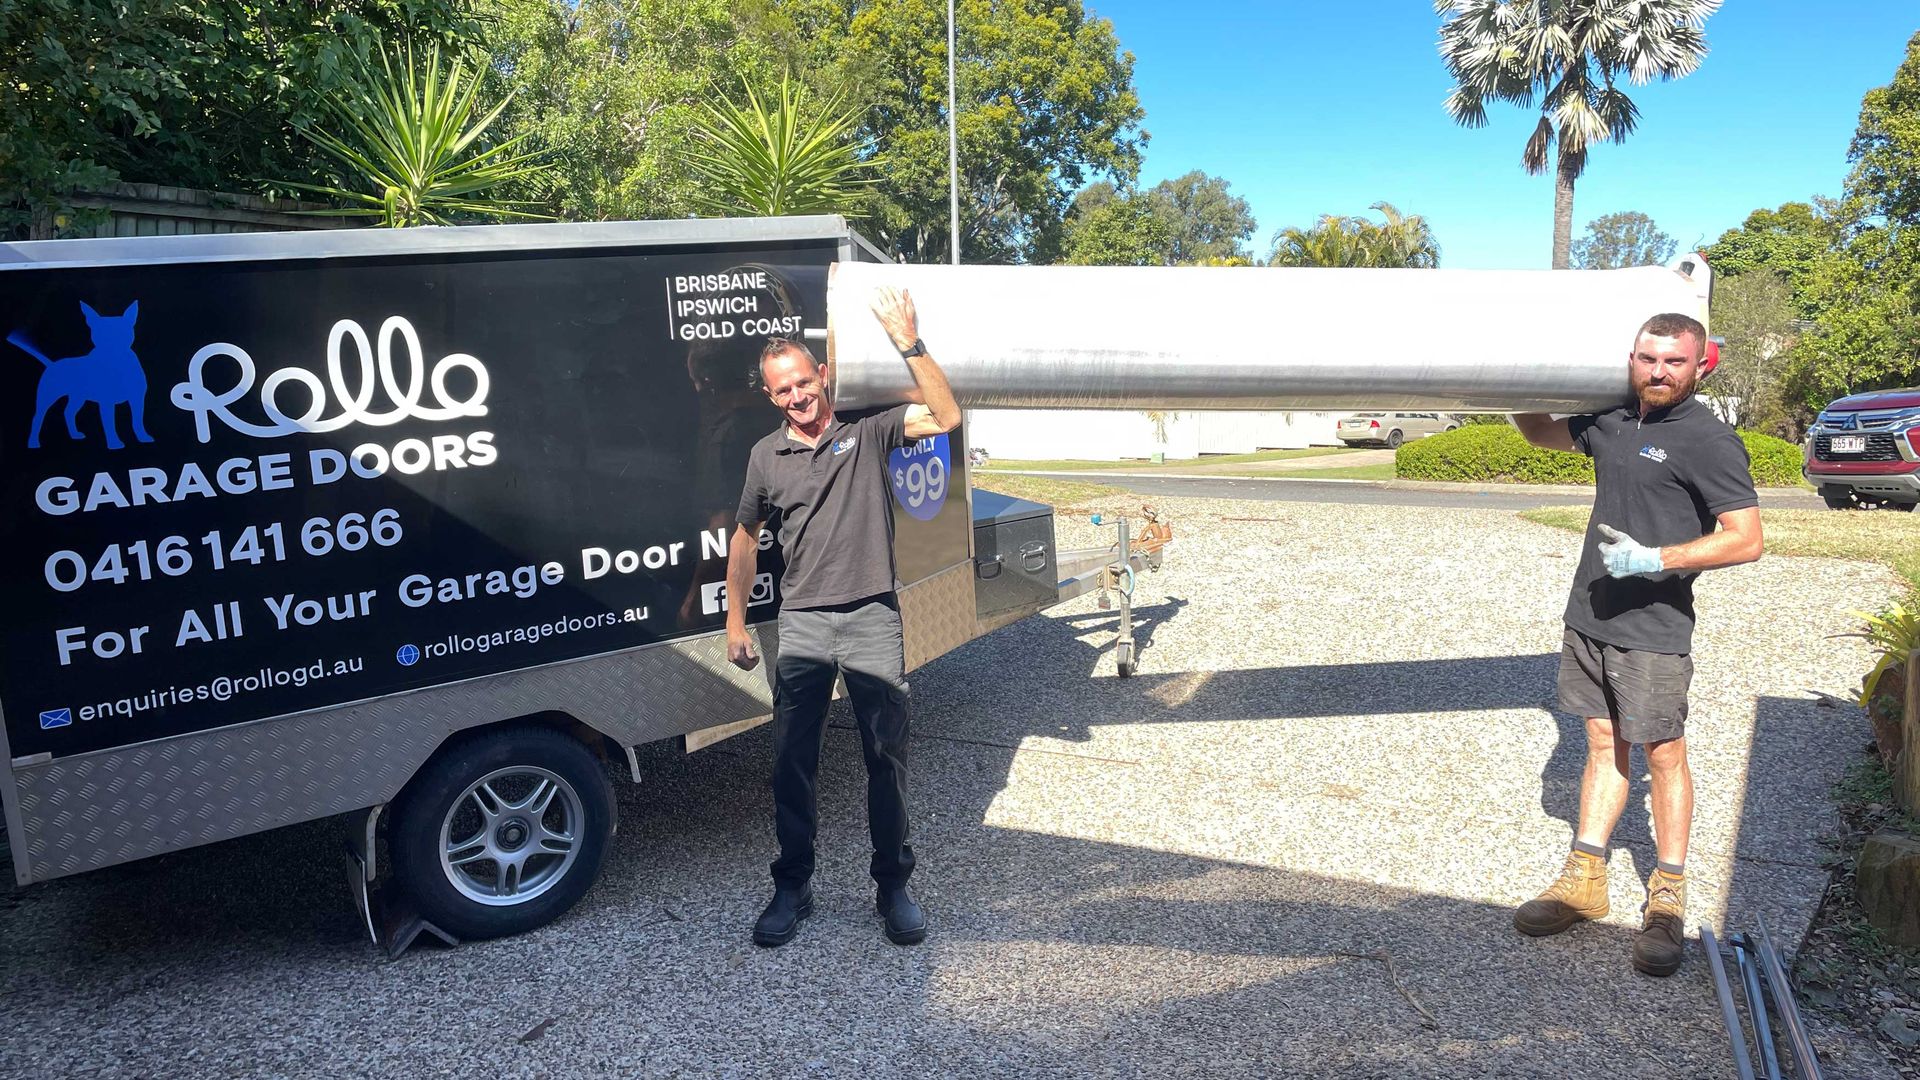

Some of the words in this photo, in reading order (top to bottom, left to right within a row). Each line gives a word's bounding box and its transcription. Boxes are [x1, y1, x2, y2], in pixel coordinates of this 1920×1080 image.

[675, 272, 767, 293] BRISBANE
[677, 296, 758, 317] IPSWICH
[680, 321, 735, 341] GOLD
[742, 316, 802, 336] COAST
[170, 316, 490, 443] Rollo
[35, 453, 294, 516] GARAGE
[309, 431, 498, 485] DOORS
[895, 456, 945, 508] $99
[45, 536, 192, 592] 0416
[202, 523, 286, 569] 141
[301, 509, 403, 555] 666
[56, 625, 150, 665] For
[175, 601, 243, 647] All
[263, 589, 377, 630] Your
[398, 562, 565, 607] Garage
[581, 542, 685, 580] Door
[424, 606, 649, 659] rollogaragedoors.au
[79, 657, 363, 721] enquiries@rollogd.au
